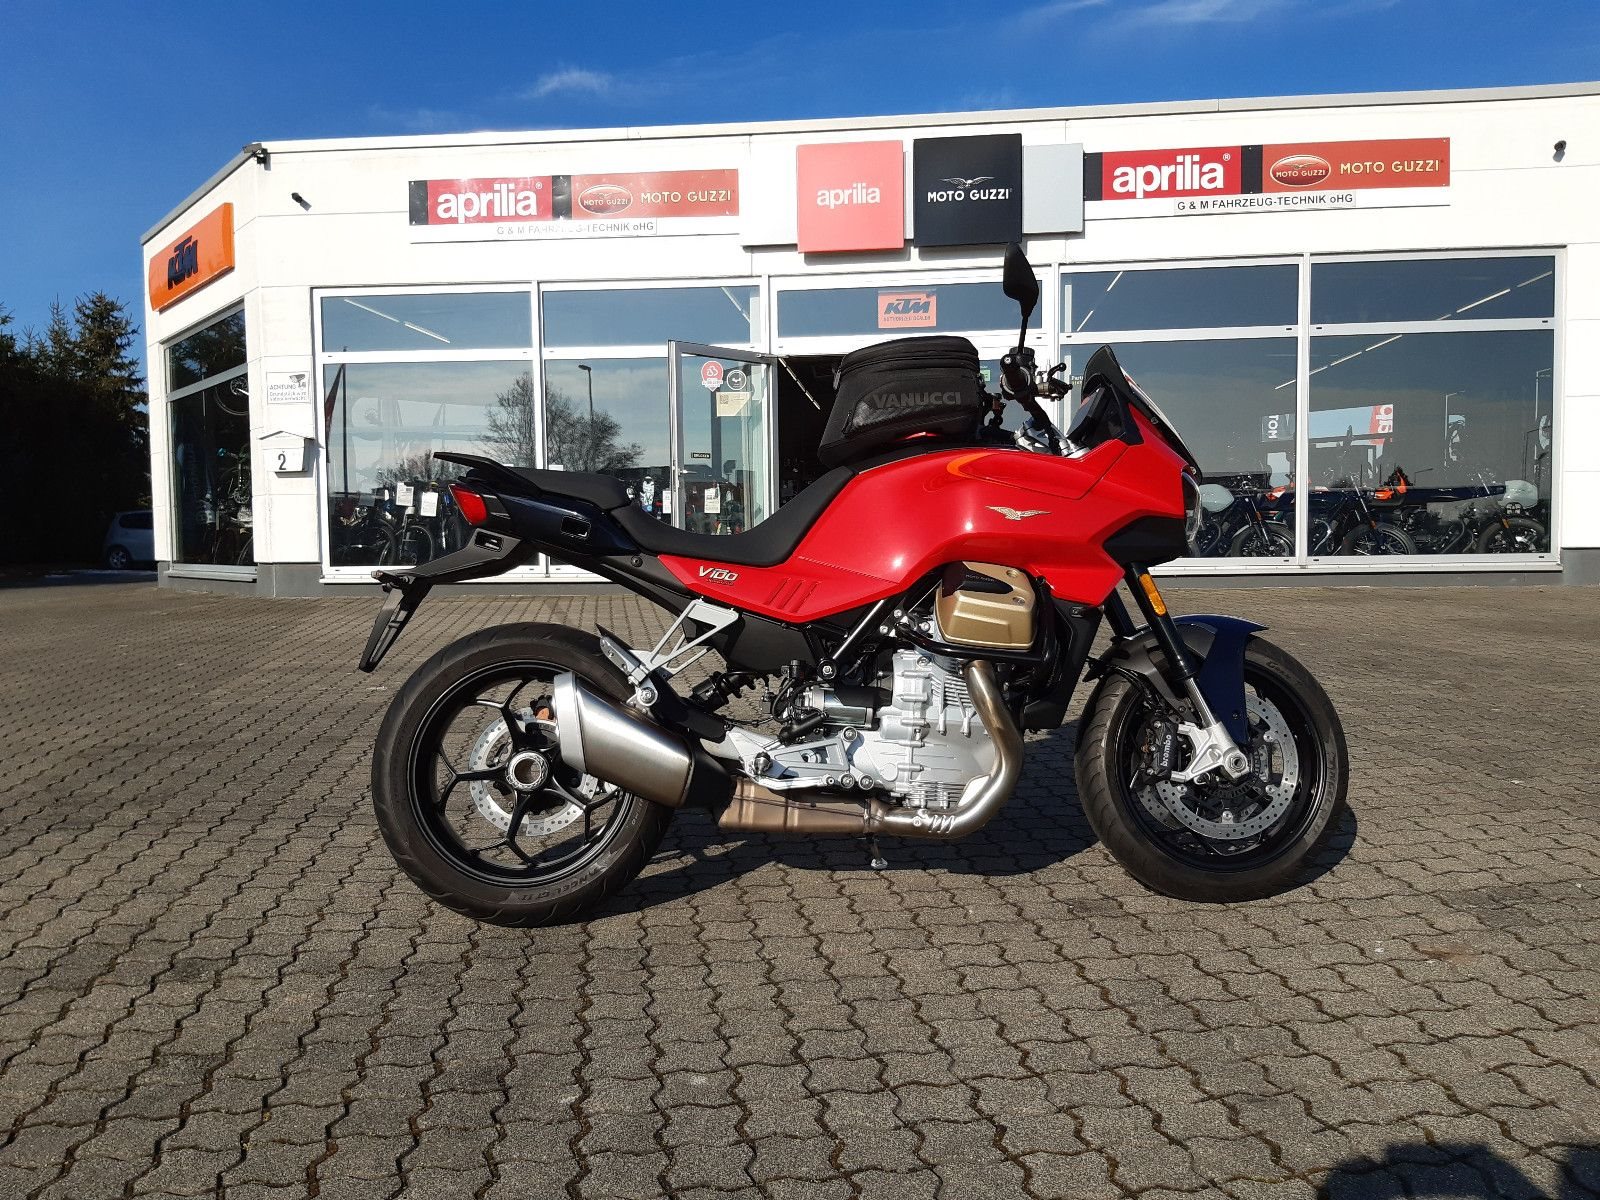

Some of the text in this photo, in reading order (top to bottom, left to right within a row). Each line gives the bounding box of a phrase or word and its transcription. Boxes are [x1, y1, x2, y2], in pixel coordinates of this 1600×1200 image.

[1275, 169, 1326, 178] MOTO GUZZI
[1340, 160, 1439, 175] MOTO GUZZI
[1113, 155, 1224, 199] aprilia
[437, 183, 537, 224] aprilia
[606, 198, 628, 206] GUZZI
[640, 190, 731, 204] MOTO GUZZI
[817, 183, 881, 209] aprilia
[927, 188, 1009, 203] MOTO GUZZI
[1177, 193, 1353, 210] G & M FAHRZEUG-TECHNIK oHG
[497, 226, 504, 235] G
[507, 226, 514, 235] &
[518, 226, 525, 235] M
[633, 221, 654, 231] oHG
[168, 235, 198, 290] KTM
[884, 298, 930, 315] KTM
[872, 391, 961, 409] VANUCCI
[278, 453, 287, 471] 2
[699, 565, 739, 581] V100
[1160, 734, 1172, 767] brembo
